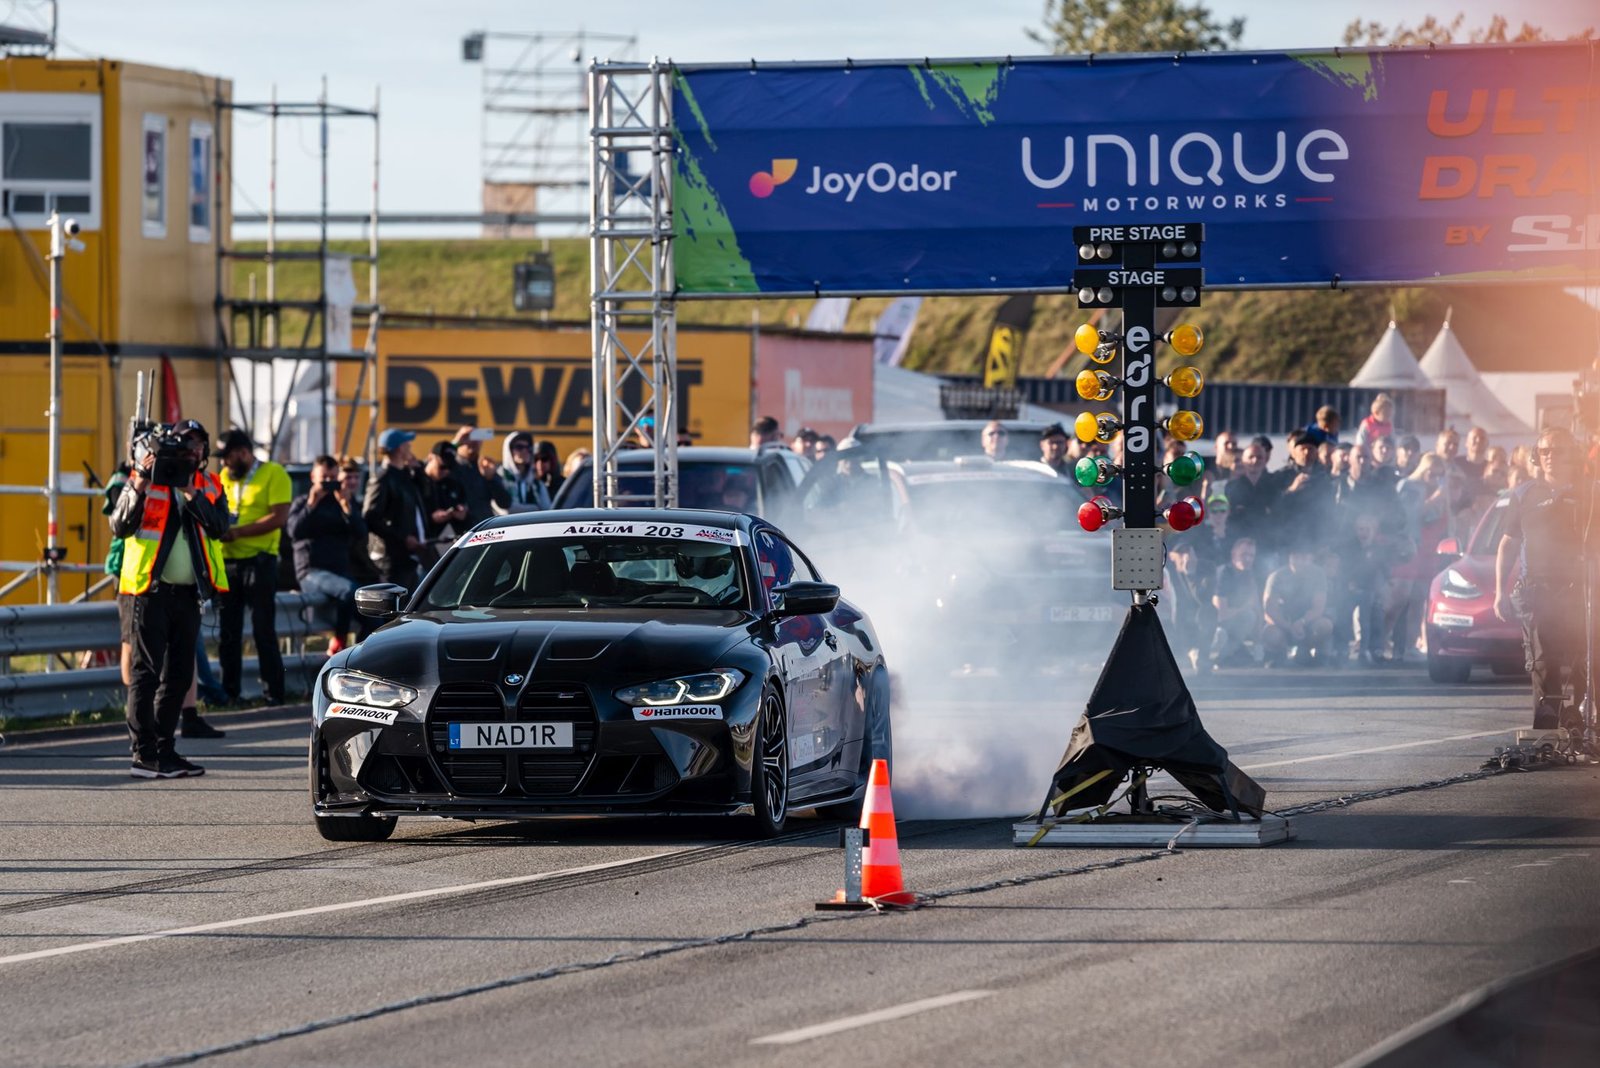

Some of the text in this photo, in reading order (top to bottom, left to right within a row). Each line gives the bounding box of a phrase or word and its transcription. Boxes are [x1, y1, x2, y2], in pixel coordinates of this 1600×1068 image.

[805, 162, 957, 202] JoyOdor
[1419, 154, 1600, 200] DRA
[1083, 193, 1287, 212] MOTORWORKS
[1090, 225, 1186, 241] PRE STAGE
[1445, 225, 1491, 246] BY
[1108, 271, 1165, 285] STAGE
[563, 525, 633, 535] AURUM
[645, 526, 685, 538] 203
[477, 725, 556, 746] NAD1R
